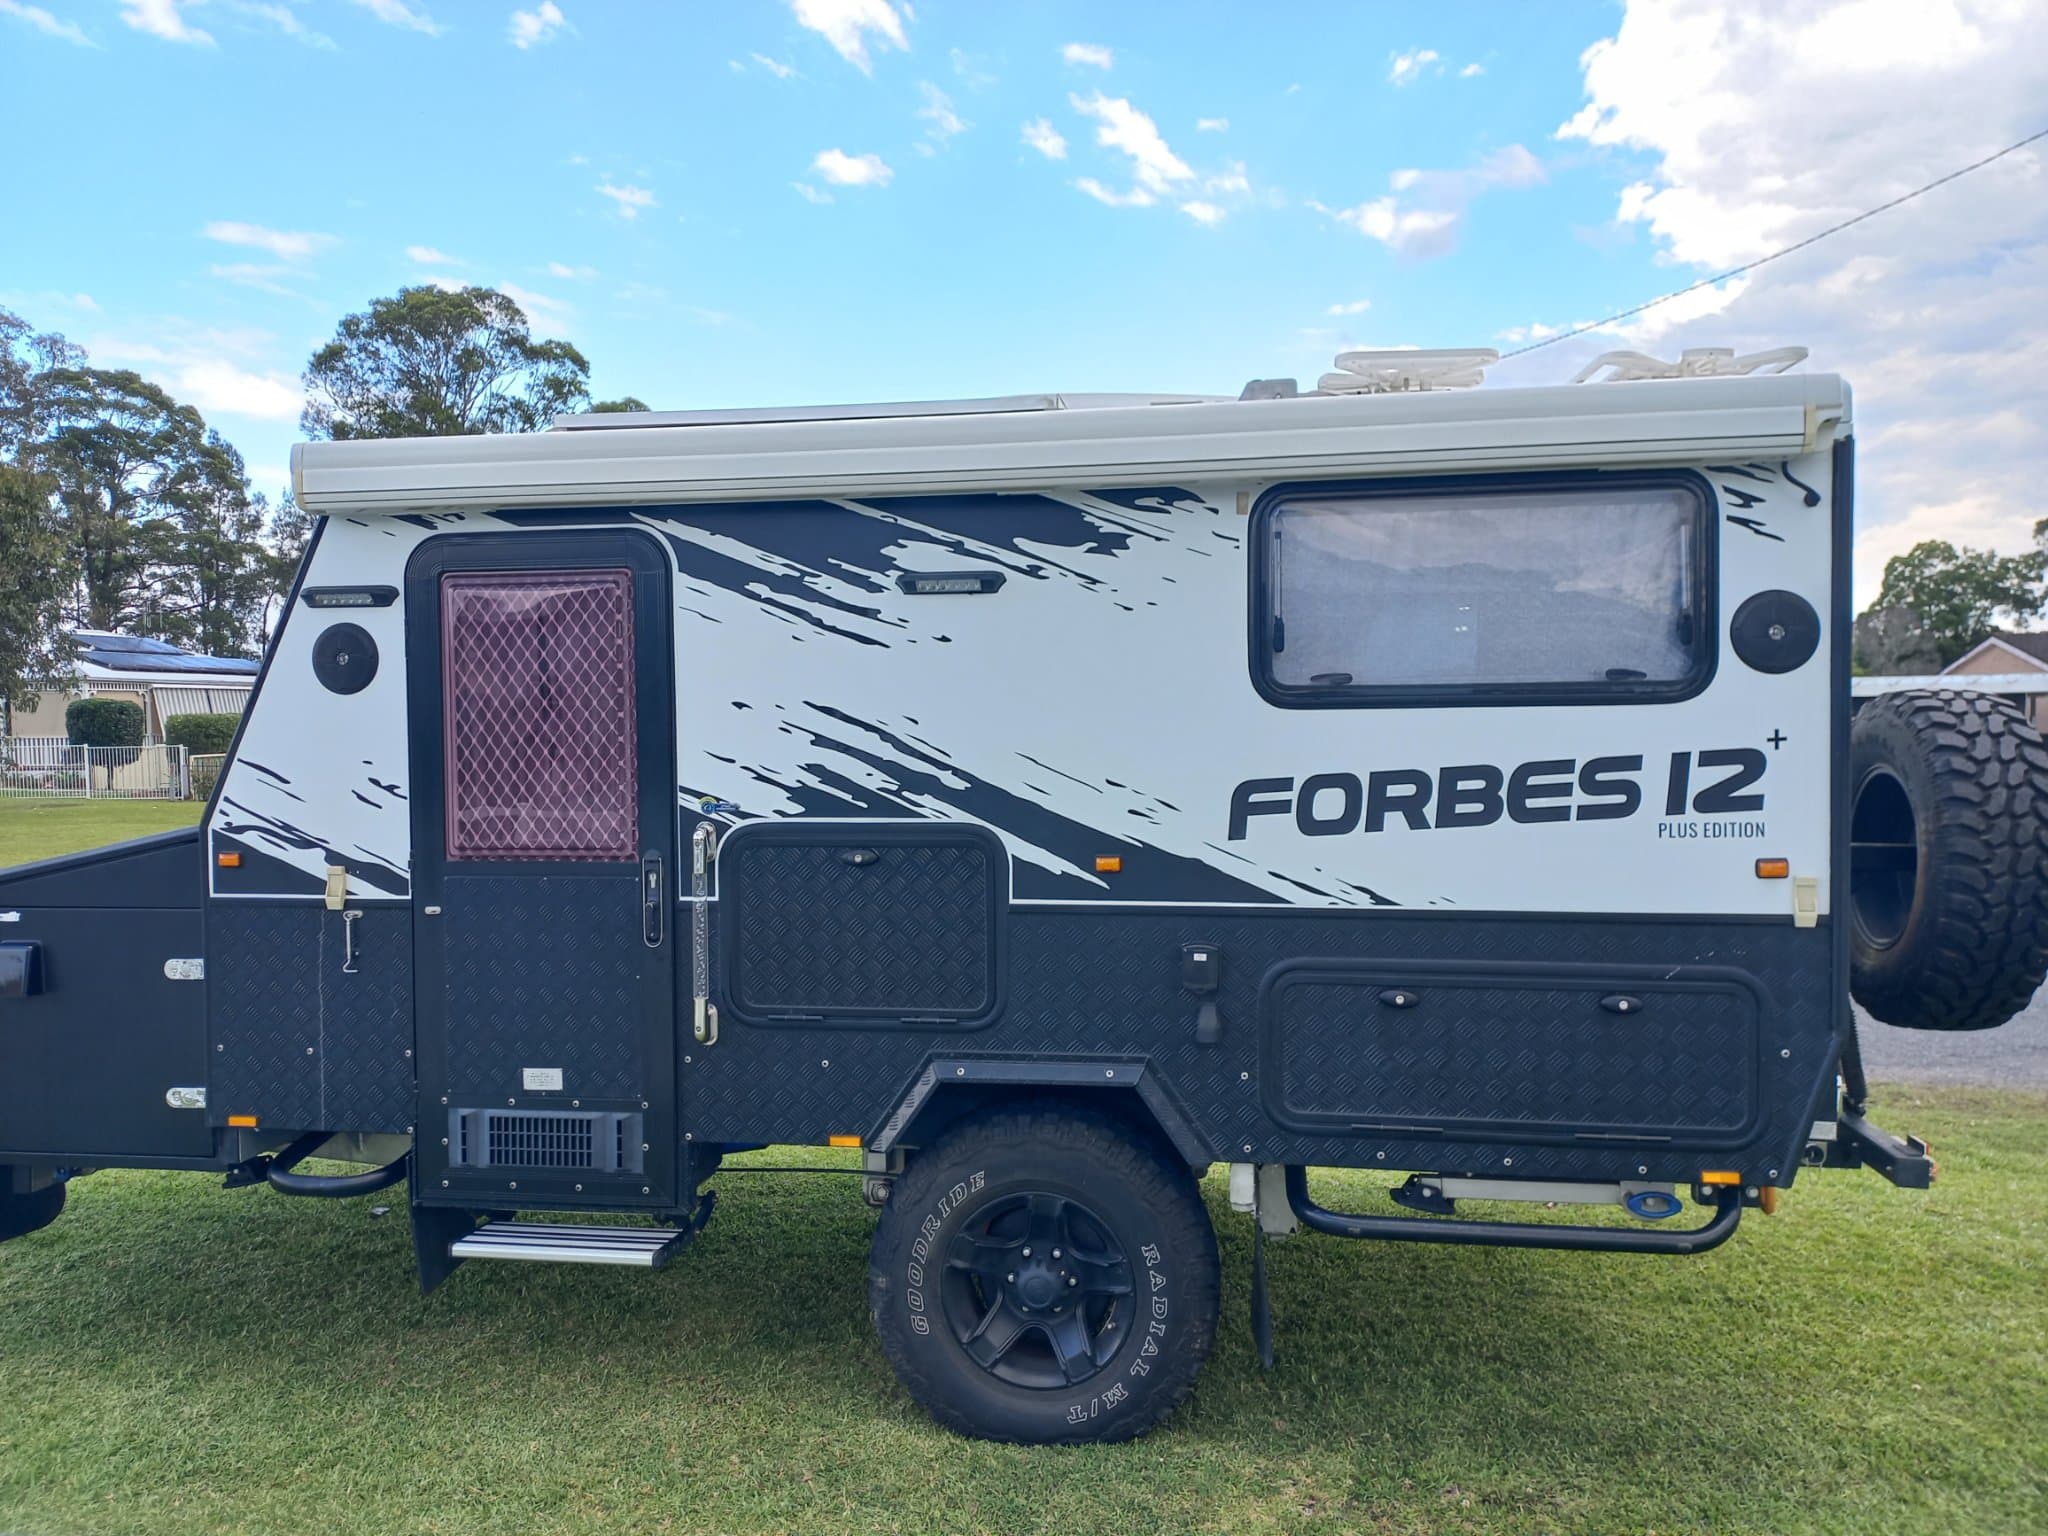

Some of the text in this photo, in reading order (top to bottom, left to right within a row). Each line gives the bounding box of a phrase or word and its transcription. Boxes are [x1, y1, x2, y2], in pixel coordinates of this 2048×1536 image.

[1228, 754, 1643, 841] FORBES
[1658, 821, 1766, 839] PLUS EDITION
[907, 1170, 986, 1336] GOODRIDE
[1066, 1243, 1168, 1424] RADIAL M/T
